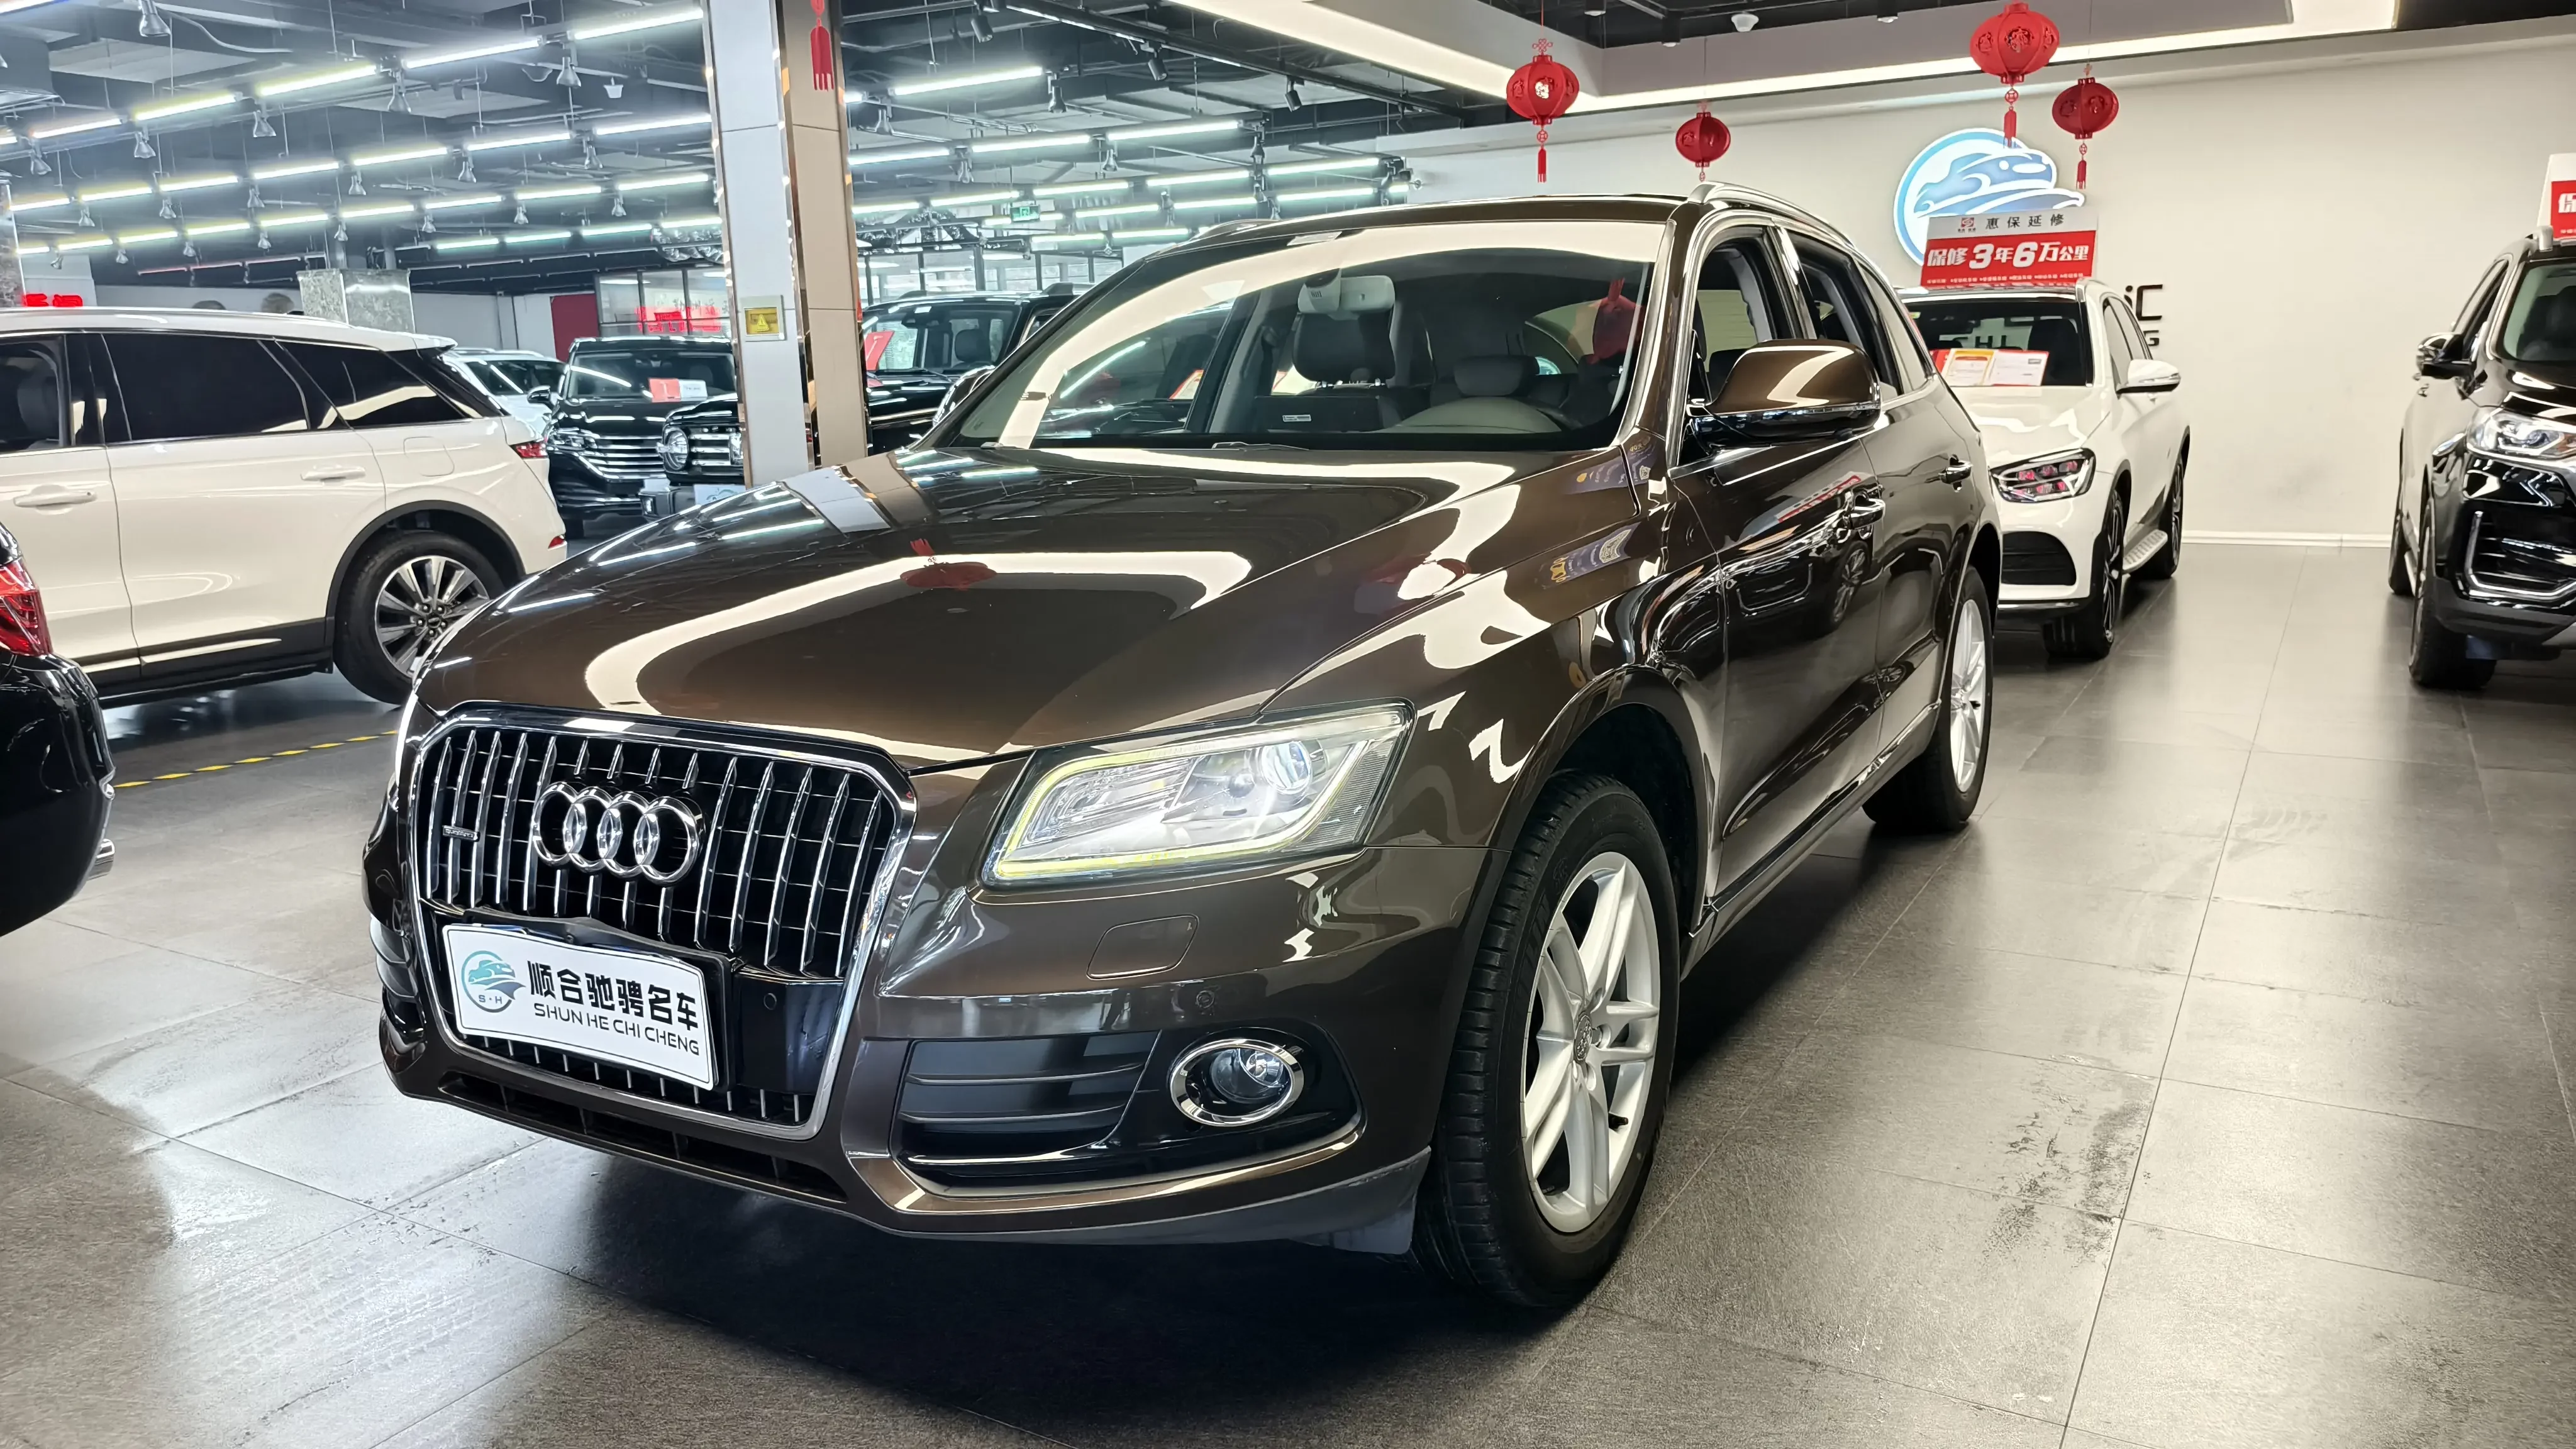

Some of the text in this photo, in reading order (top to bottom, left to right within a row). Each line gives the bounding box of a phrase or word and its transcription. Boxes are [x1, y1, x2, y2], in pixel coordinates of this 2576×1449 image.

[1985, 213, 2065, 230] 惠保延修
[527, 960, 699, 1031] 顺合驰骋名车
[534, 1002, 699, 1056] SHUN HE CHI CHENG
